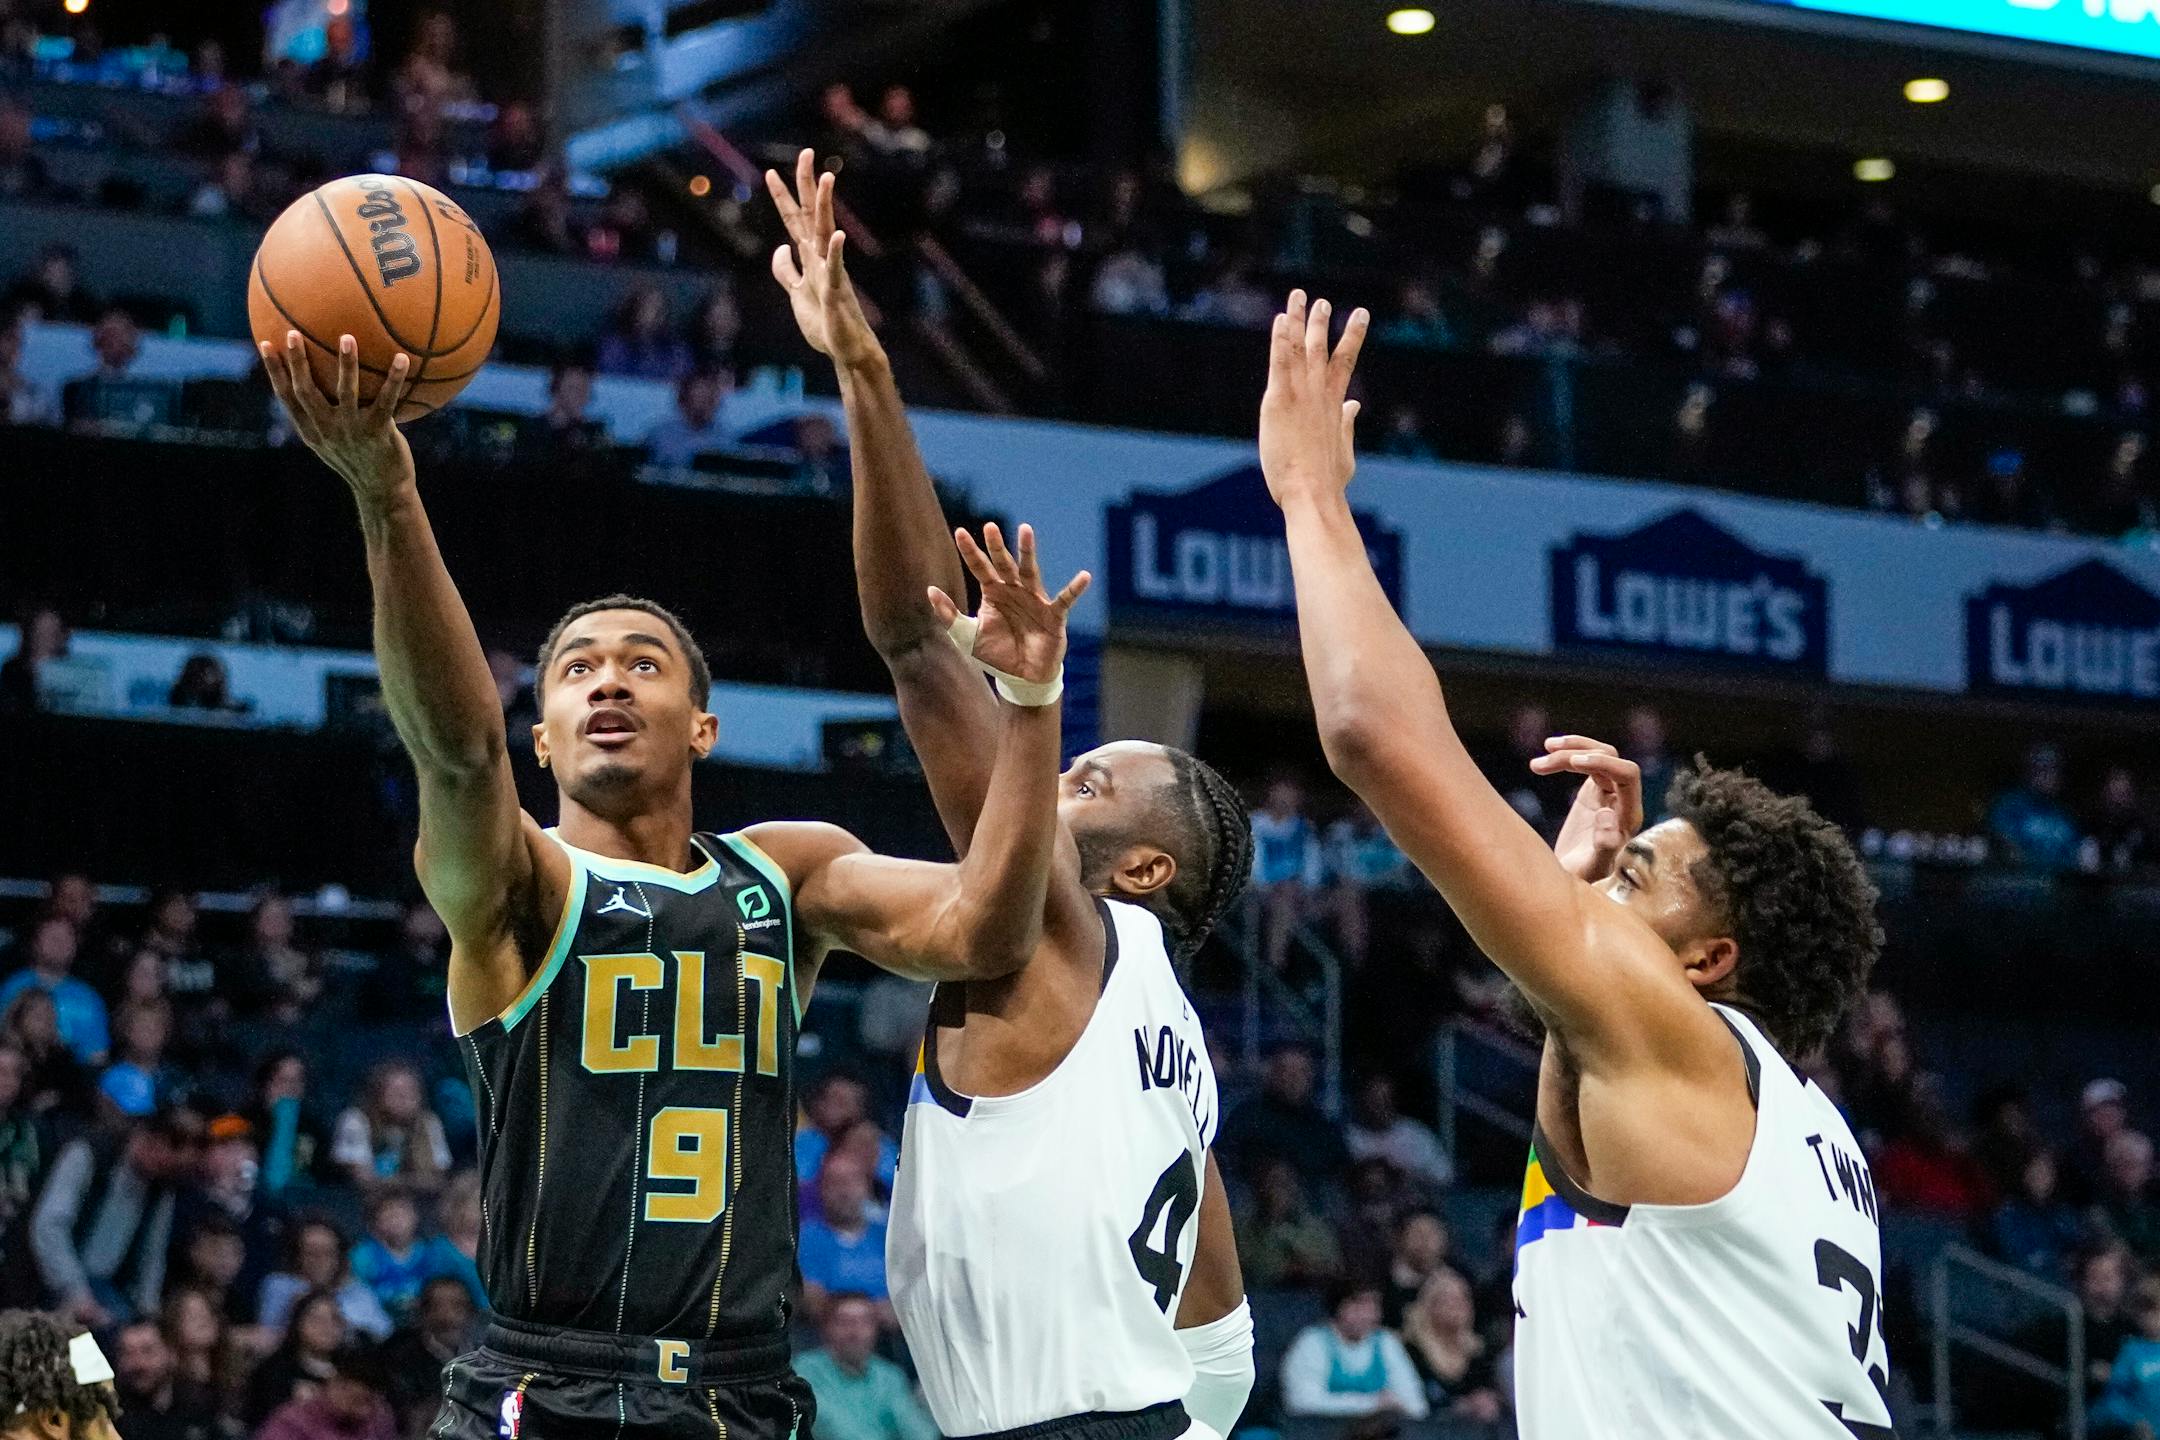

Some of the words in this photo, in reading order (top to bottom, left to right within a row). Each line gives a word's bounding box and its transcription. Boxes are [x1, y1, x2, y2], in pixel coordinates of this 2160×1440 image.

[1132, 513, 1290, 608] LOW
[1575, 553, 1807, 661] LOWE'S
[1990, 604, 2160, 697] LOWE
[578, 951, 786, 1078] CLT
[644, 1106, 728, 1224] 9
[1128, 1147, 1198, 1315] 4
[655, 1339, 690, 1383] C
